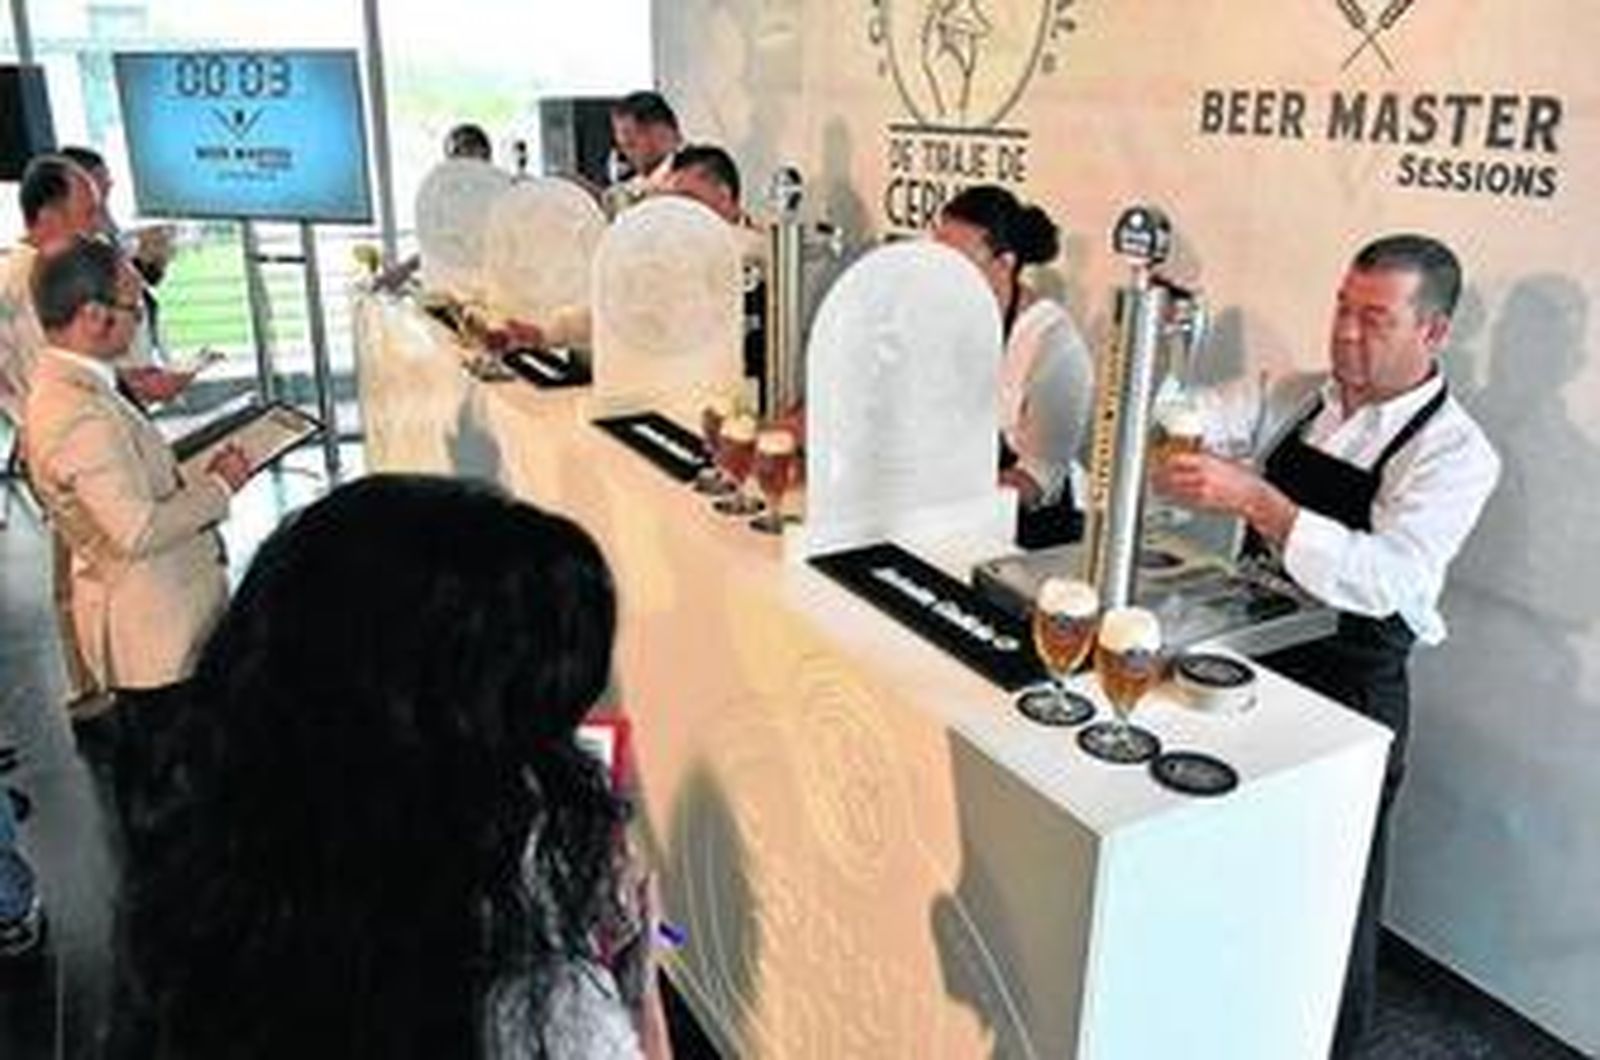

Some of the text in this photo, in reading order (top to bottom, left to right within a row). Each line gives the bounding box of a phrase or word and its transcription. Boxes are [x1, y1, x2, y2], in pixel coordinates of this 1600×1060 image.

[1201, 91, 1563, 154] BEER MASTER
[997, 144, 1026, 182] DE
[1398, 152, 1556, 198] SESSIONS
